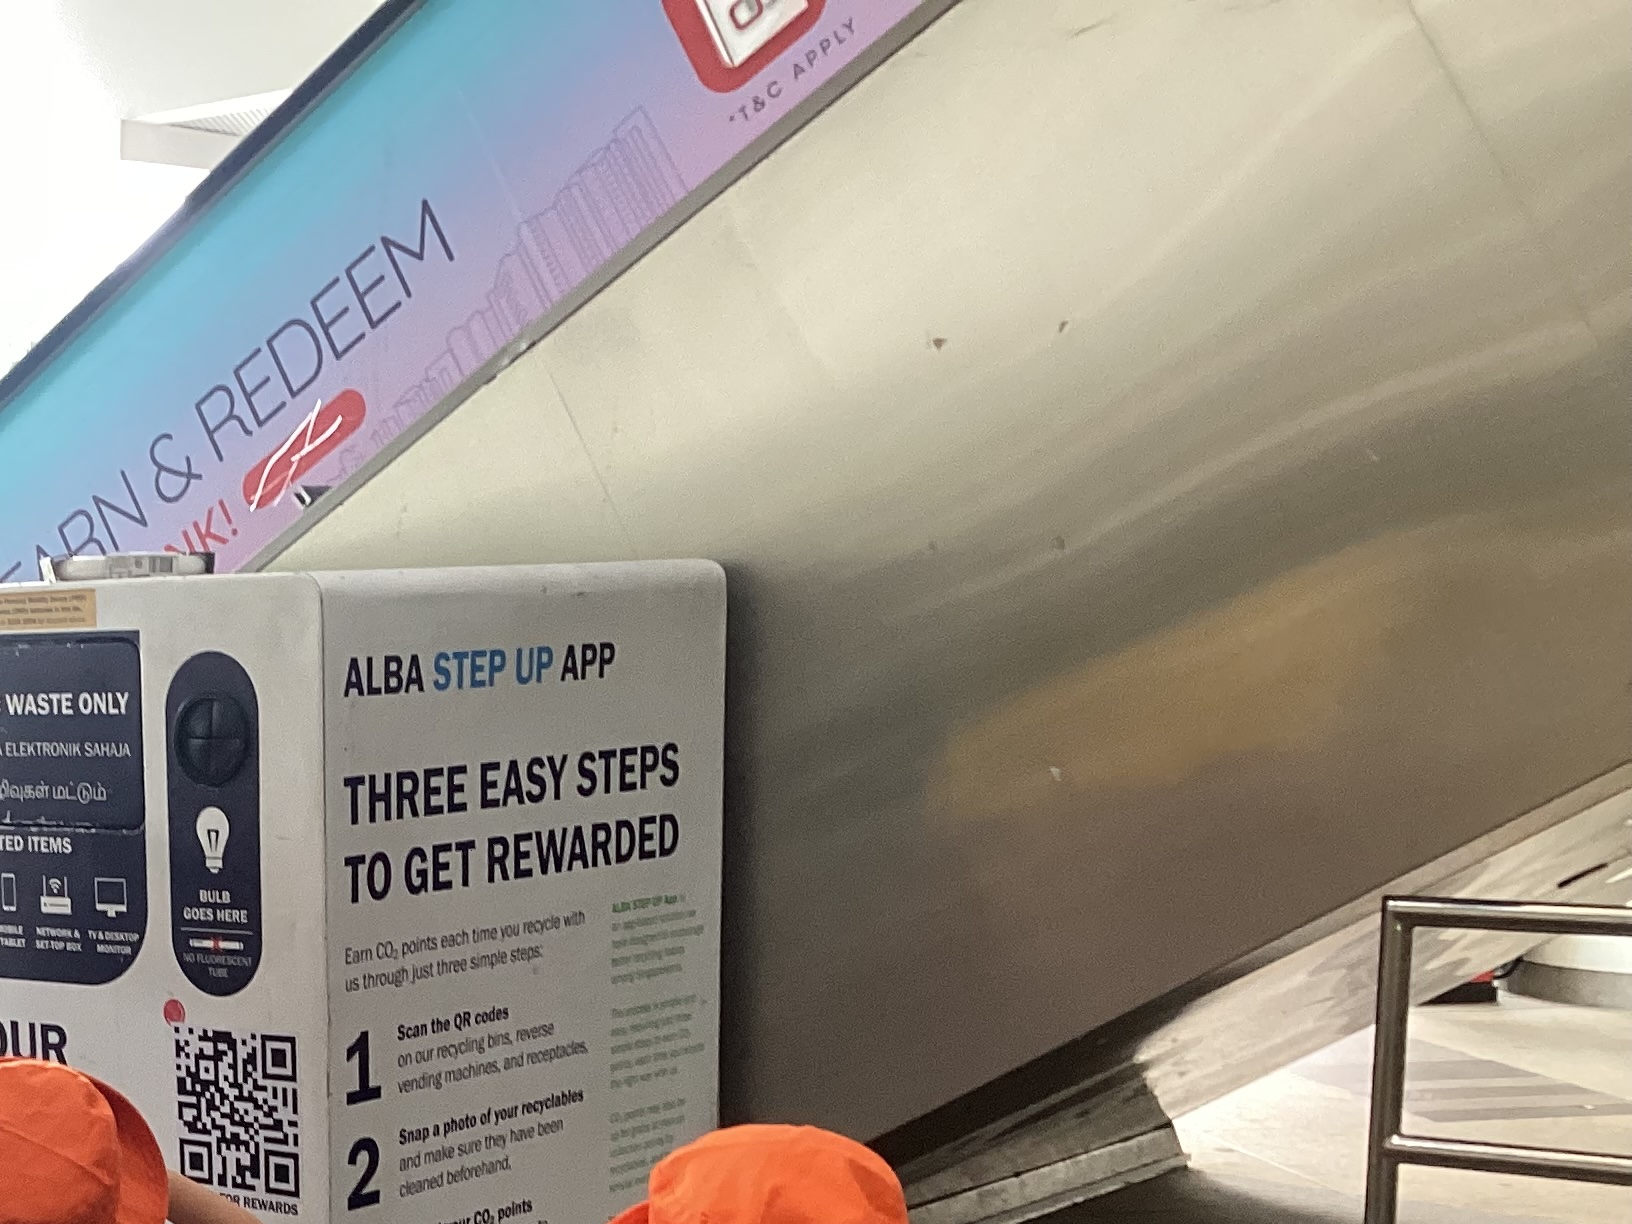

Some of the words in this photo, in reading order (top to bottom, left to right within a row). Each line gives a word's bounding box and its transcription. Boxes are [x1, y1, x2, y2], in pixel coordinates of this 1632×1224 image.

[791, 16, 856, 80] APPLY
[149, 432, 203, 504] &
[194, 197, 455, 463] REDEEM
[343, 653, 425, 698] ALBA
[433, 648, 506, 691] STEP
[515, 645, 553, 685] UP
[561, 641, 616, 682] APP
[5, 692, 74, 716] WASTE
[78, 691, 129, 715] ONLY
[5, 743, 82, 757] ELEKTRONIK
[84, 743, 131, 758] SAHAJA
[343, 764, 468, 826] THREE
[480, 753, 569, 809] EASY
[576, 742, 680, 798] STEPS
[28, 836, 73, 854] ITEMS
[344, 851, 392, 904] TO
[404, 840, 476, 895] GET
[487, 813, 680, 884] REWARDED
[199, 889, 231, 904] BULB
[183, 907, 213, 921] GOES
[216, 909, 248, 924] HERE
[0, 937, 26, 948] TABLET
[35, 927, 72, 938] NETWORK
[66, 942, 82, 952] BOX
[104, 931, 139, 942] DESKTOP
[344, 947, 373, 965] Earn
[401, 936, 438, 958] points
[440, 929, 468, 947] each
[472, 926, 498, 944] time
[499, 923, 520, 943] you
[522, 913, 561, 936] recycle
[562, 910, 585, 928] with
[96, 944, 131, 955] MONITOR
[183, 952, 195, 963] NO
[345, 976, 359, 993] us
[363, 966, 409, 988] through
[412, 962, 434, 984] just
[436, 958, 467, 976] three
[469, 949, 508, 971] simple
[397, 1023, 428, 1042] Scan
[431, 1015, 451, 1033] the
[453, 1011, 472, 1031] QR
[474, 1006, 509, 1026] codes
[397, 1051, 412, 1068] on
[414, 1046, 434, 1063] our
[436, 1037, 486, 1060] recycling
[487, 1031, 513, 1050] bins,
[515, 1022, 555, 1042] reverse
[346, 1029, 382, 1106] 1
[397, 1073, 443, 1094] vending
[503, 1052, 524, 1069] and
[399, 1127, 430, 1146] Snap
[432, 1125, 440, 1137] a
[443, 1115, 477, 1139] photo
[480, 1107, 492, 1126] of
[494, 1105, 519, 1126] your
[521, 1088, 584, 1117] recyclables
[399, 1154, 421, 1172] and
[424, 1145, 455, 1165] make
[457, 1141, 482, 1157] sure
[484, 1131, 508, 1151] they
[510, 1125, 535, 1143] have
[537, 1119, 564, 1138] been
[347, 1137, 381, 1211] 2
[399, 1172, 444, 1198] cleaned
[243, 1196, 298, 1216] REWARDS
[497, 1198, 533, 1221] points
